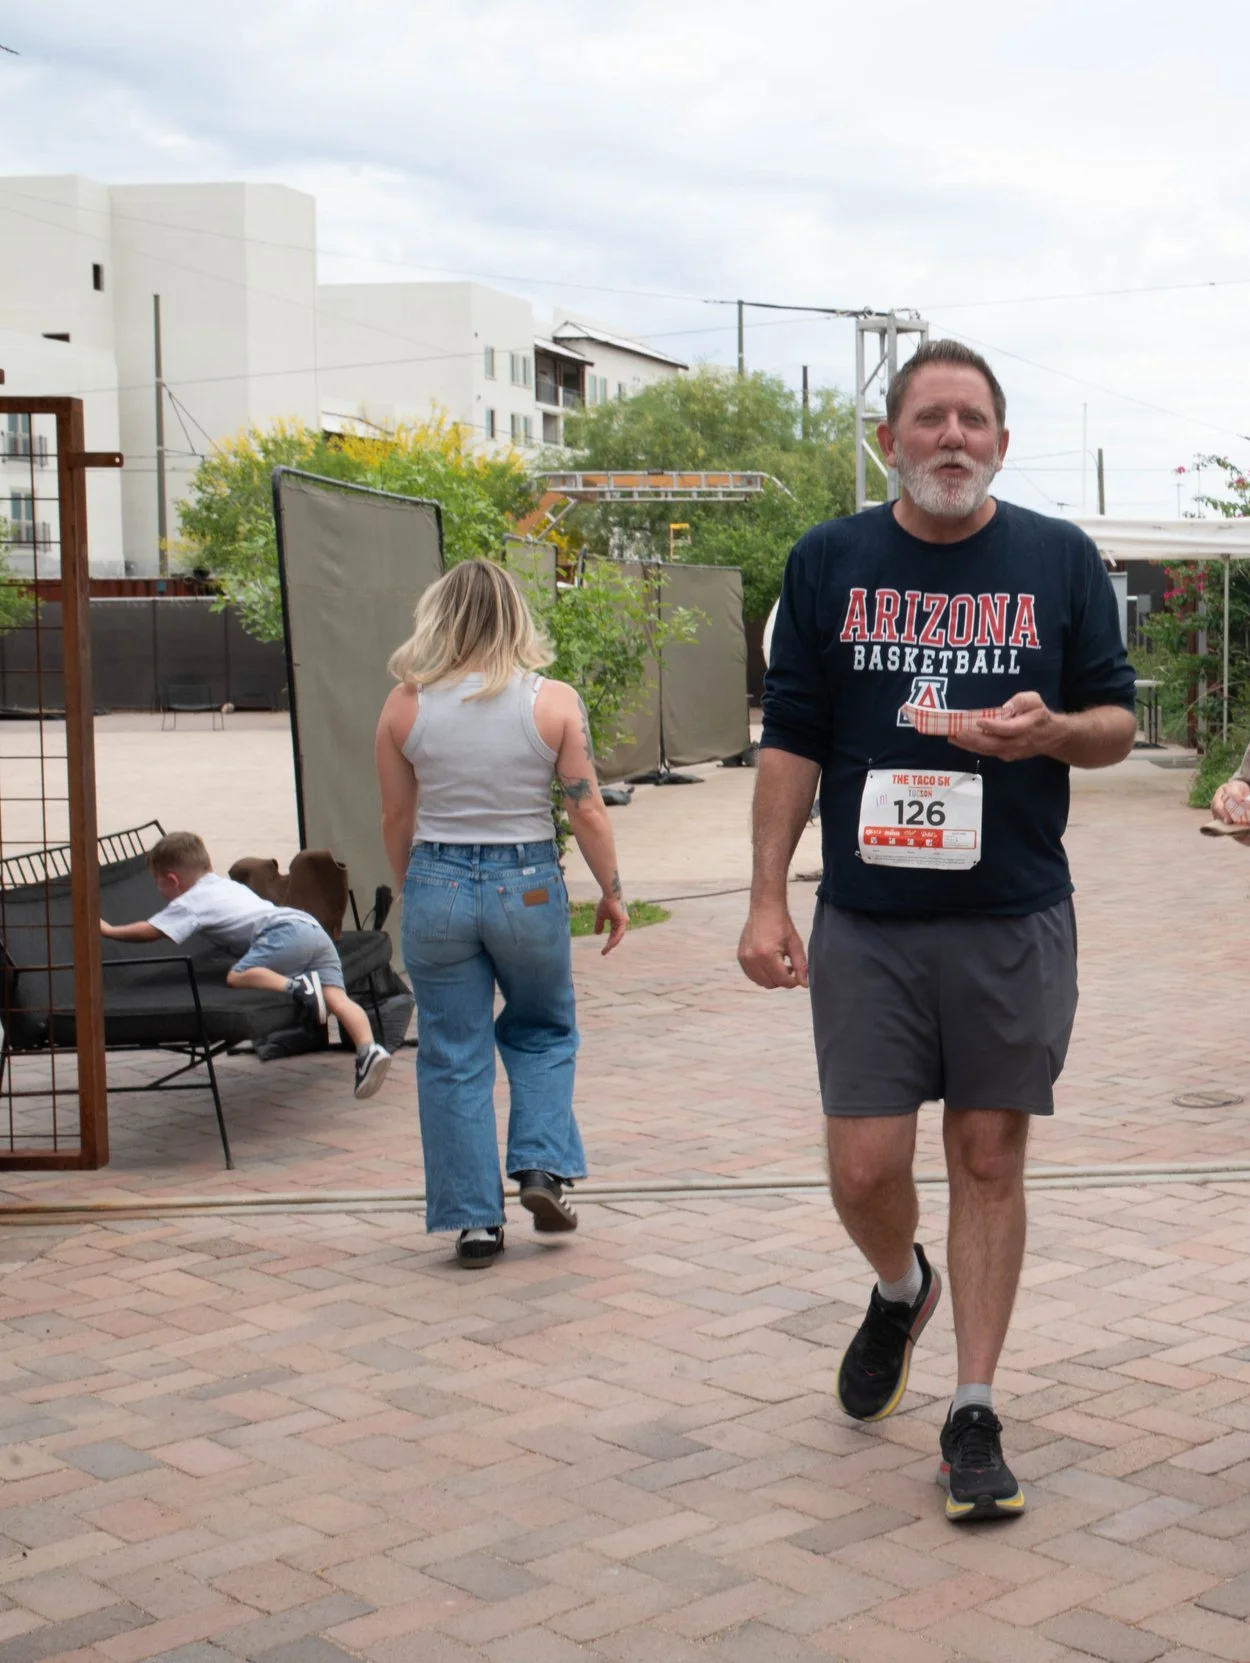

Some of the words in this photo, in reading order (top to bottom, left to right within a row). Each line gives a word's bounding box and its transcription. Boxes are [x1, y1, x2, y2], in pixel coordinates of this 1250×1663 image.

[840, 588, 1041, 649] ARIZONA
[853, 645, 1020, 674] BASKETBALL
[892, 774, 909, 785] THE
[911, 775, 936, 786] TACO
[937, 776, 951, 787] 5K
[893, 799, 946, 826] 126
